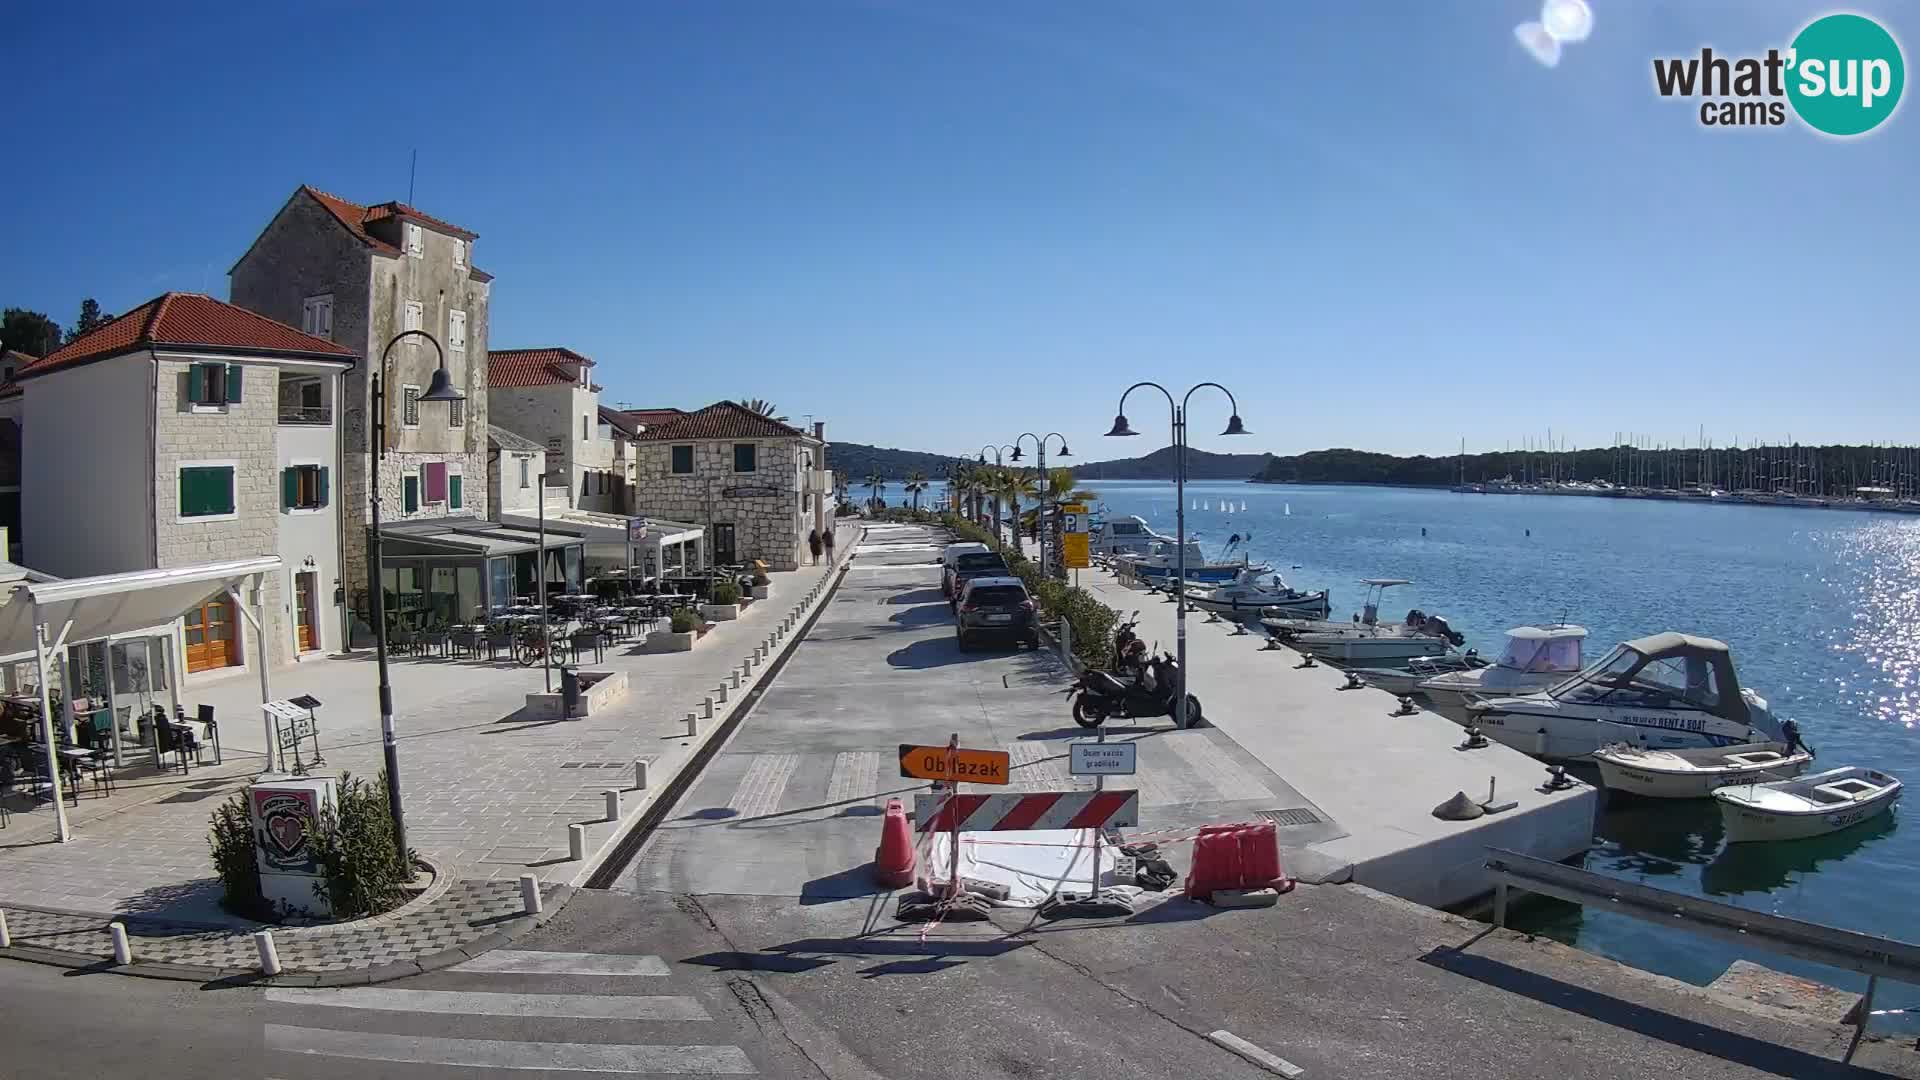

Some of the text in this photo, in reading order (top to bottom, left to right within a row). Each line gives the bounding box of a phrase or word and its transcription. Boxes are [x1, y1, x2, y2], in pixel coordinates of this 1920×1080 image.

[1659, 718, 1679, 730] RENT
[1687, 719, 1706, 732] BOAT
[924, 756, 1000, 776] Oblazak
